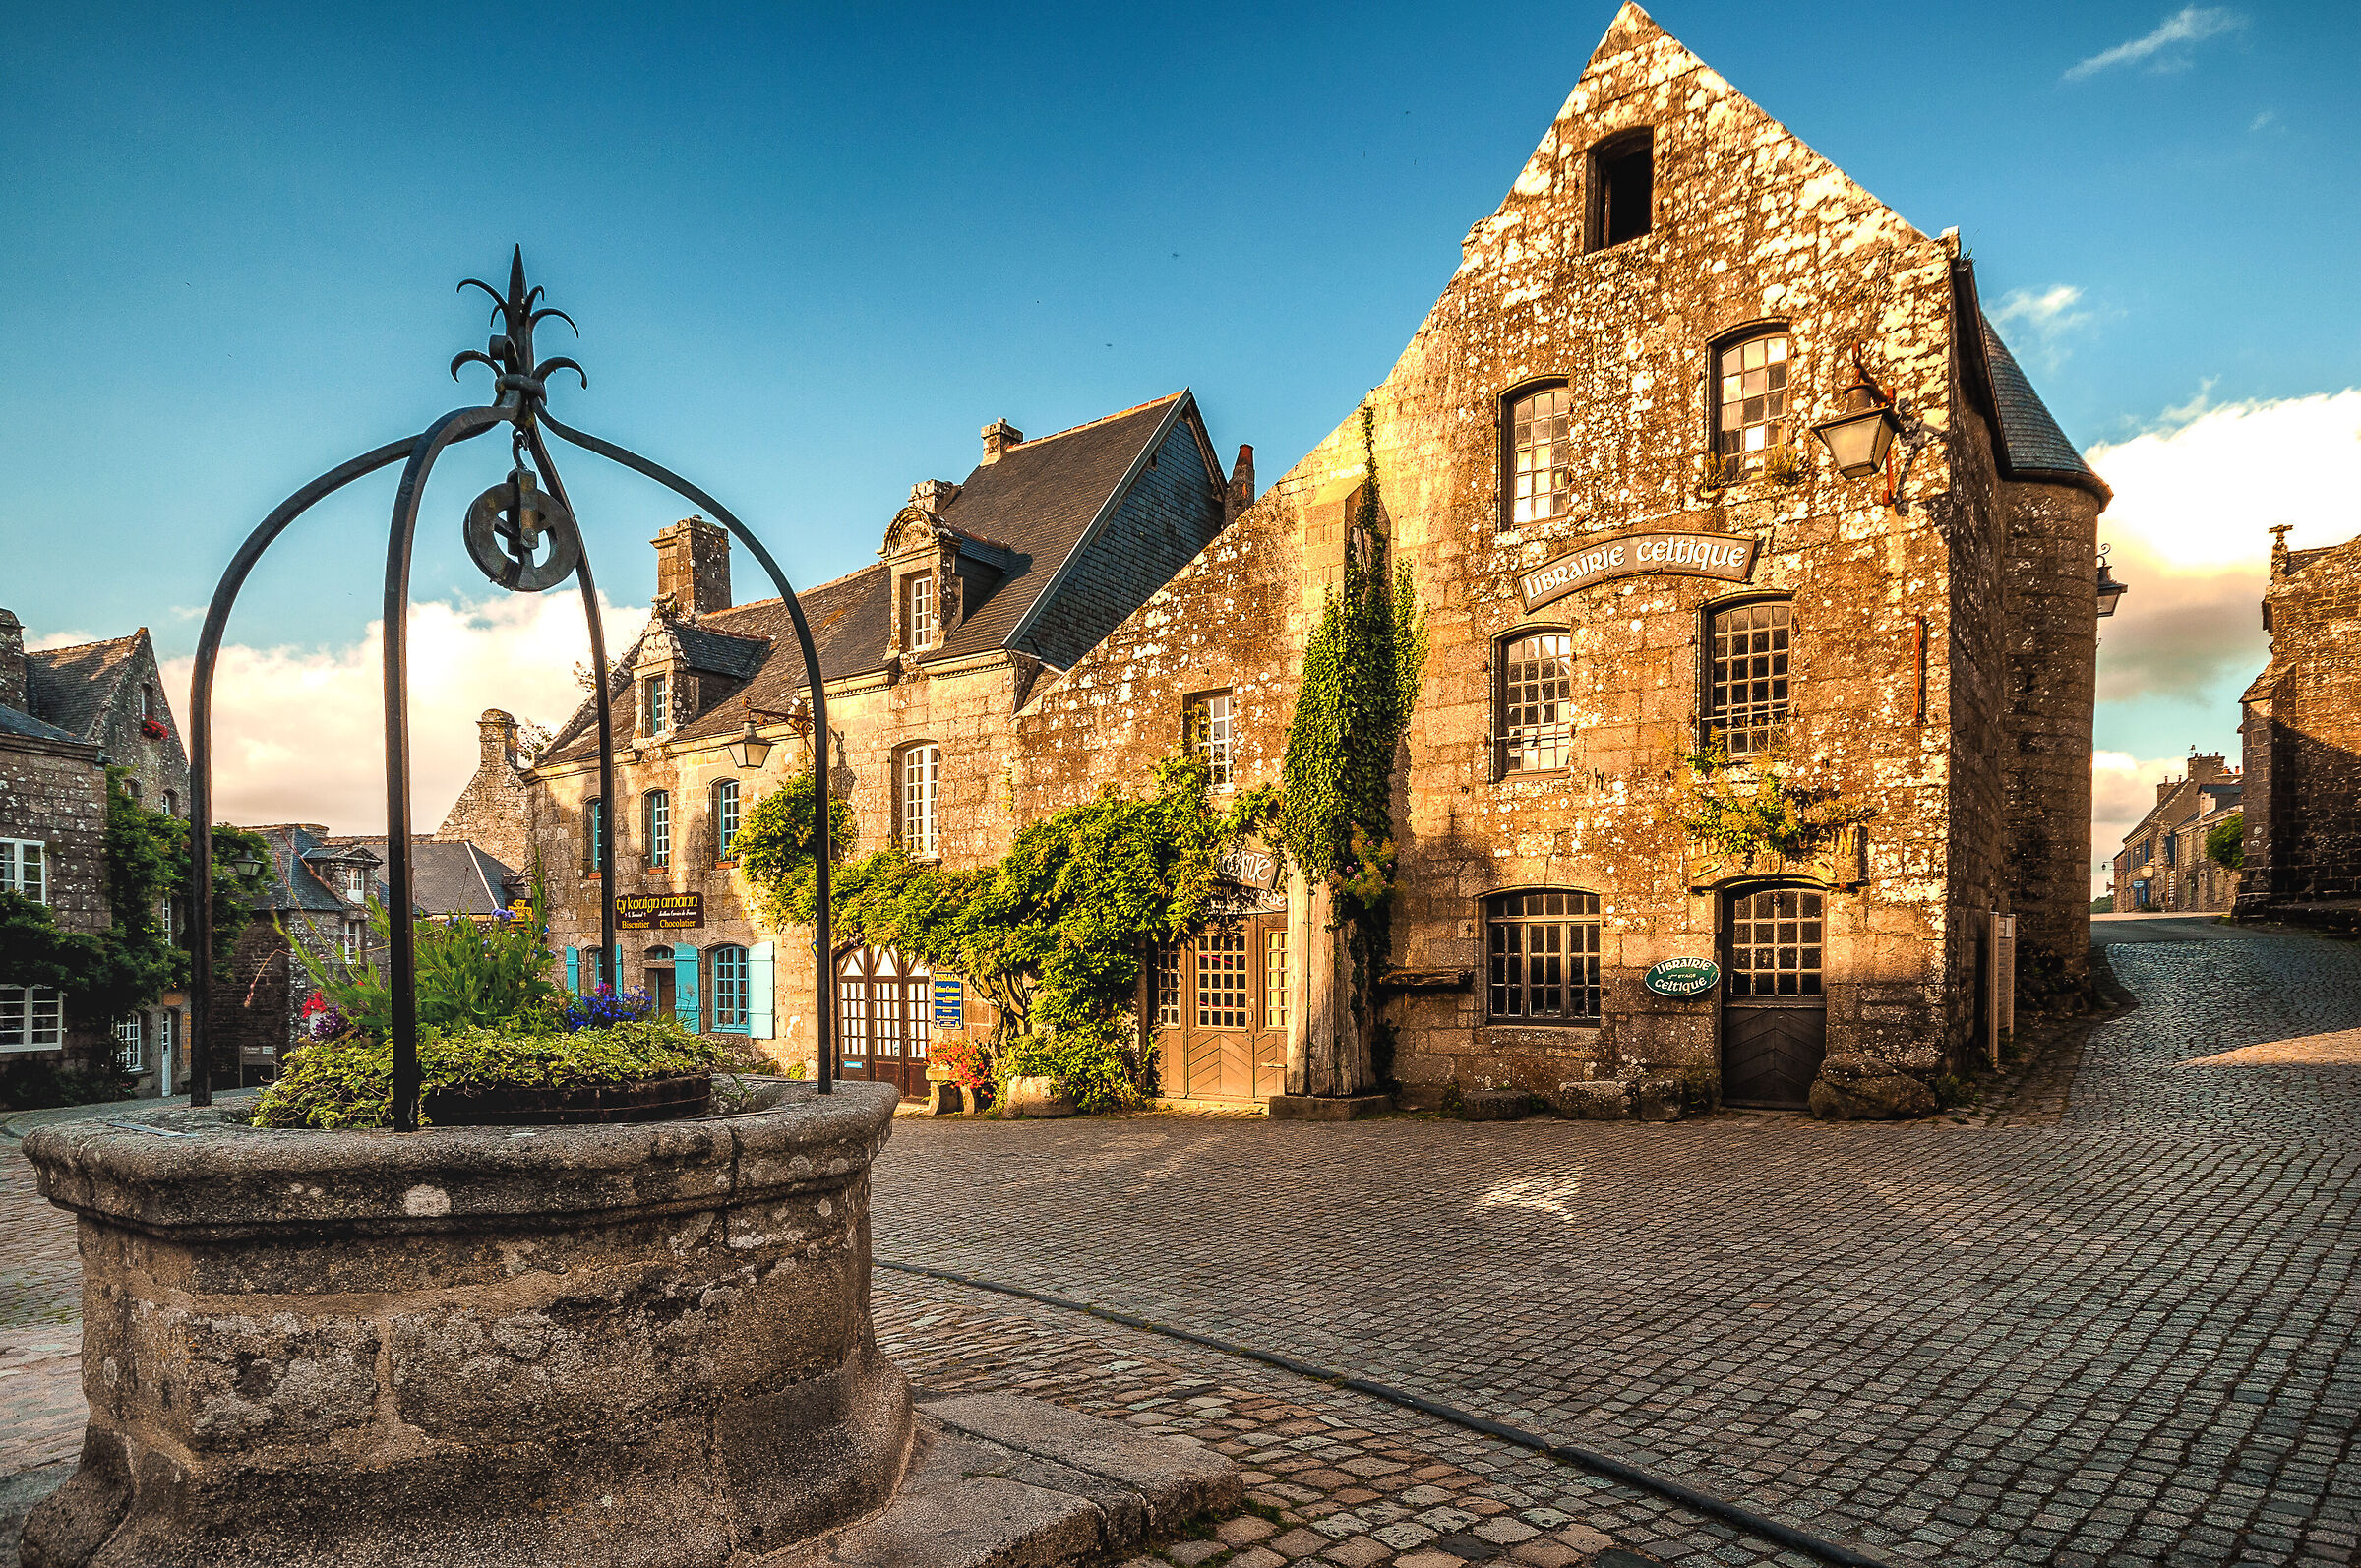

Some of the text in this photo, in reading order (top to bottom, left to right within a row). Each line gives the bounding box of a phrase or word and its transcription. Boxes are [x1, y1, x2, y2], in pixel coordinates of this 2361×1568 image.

[628, 896, 659, 914] kouign
[661, 895, 698, 908] amann
[622, 919, 696, 929] Biscuitier Chocolatier
